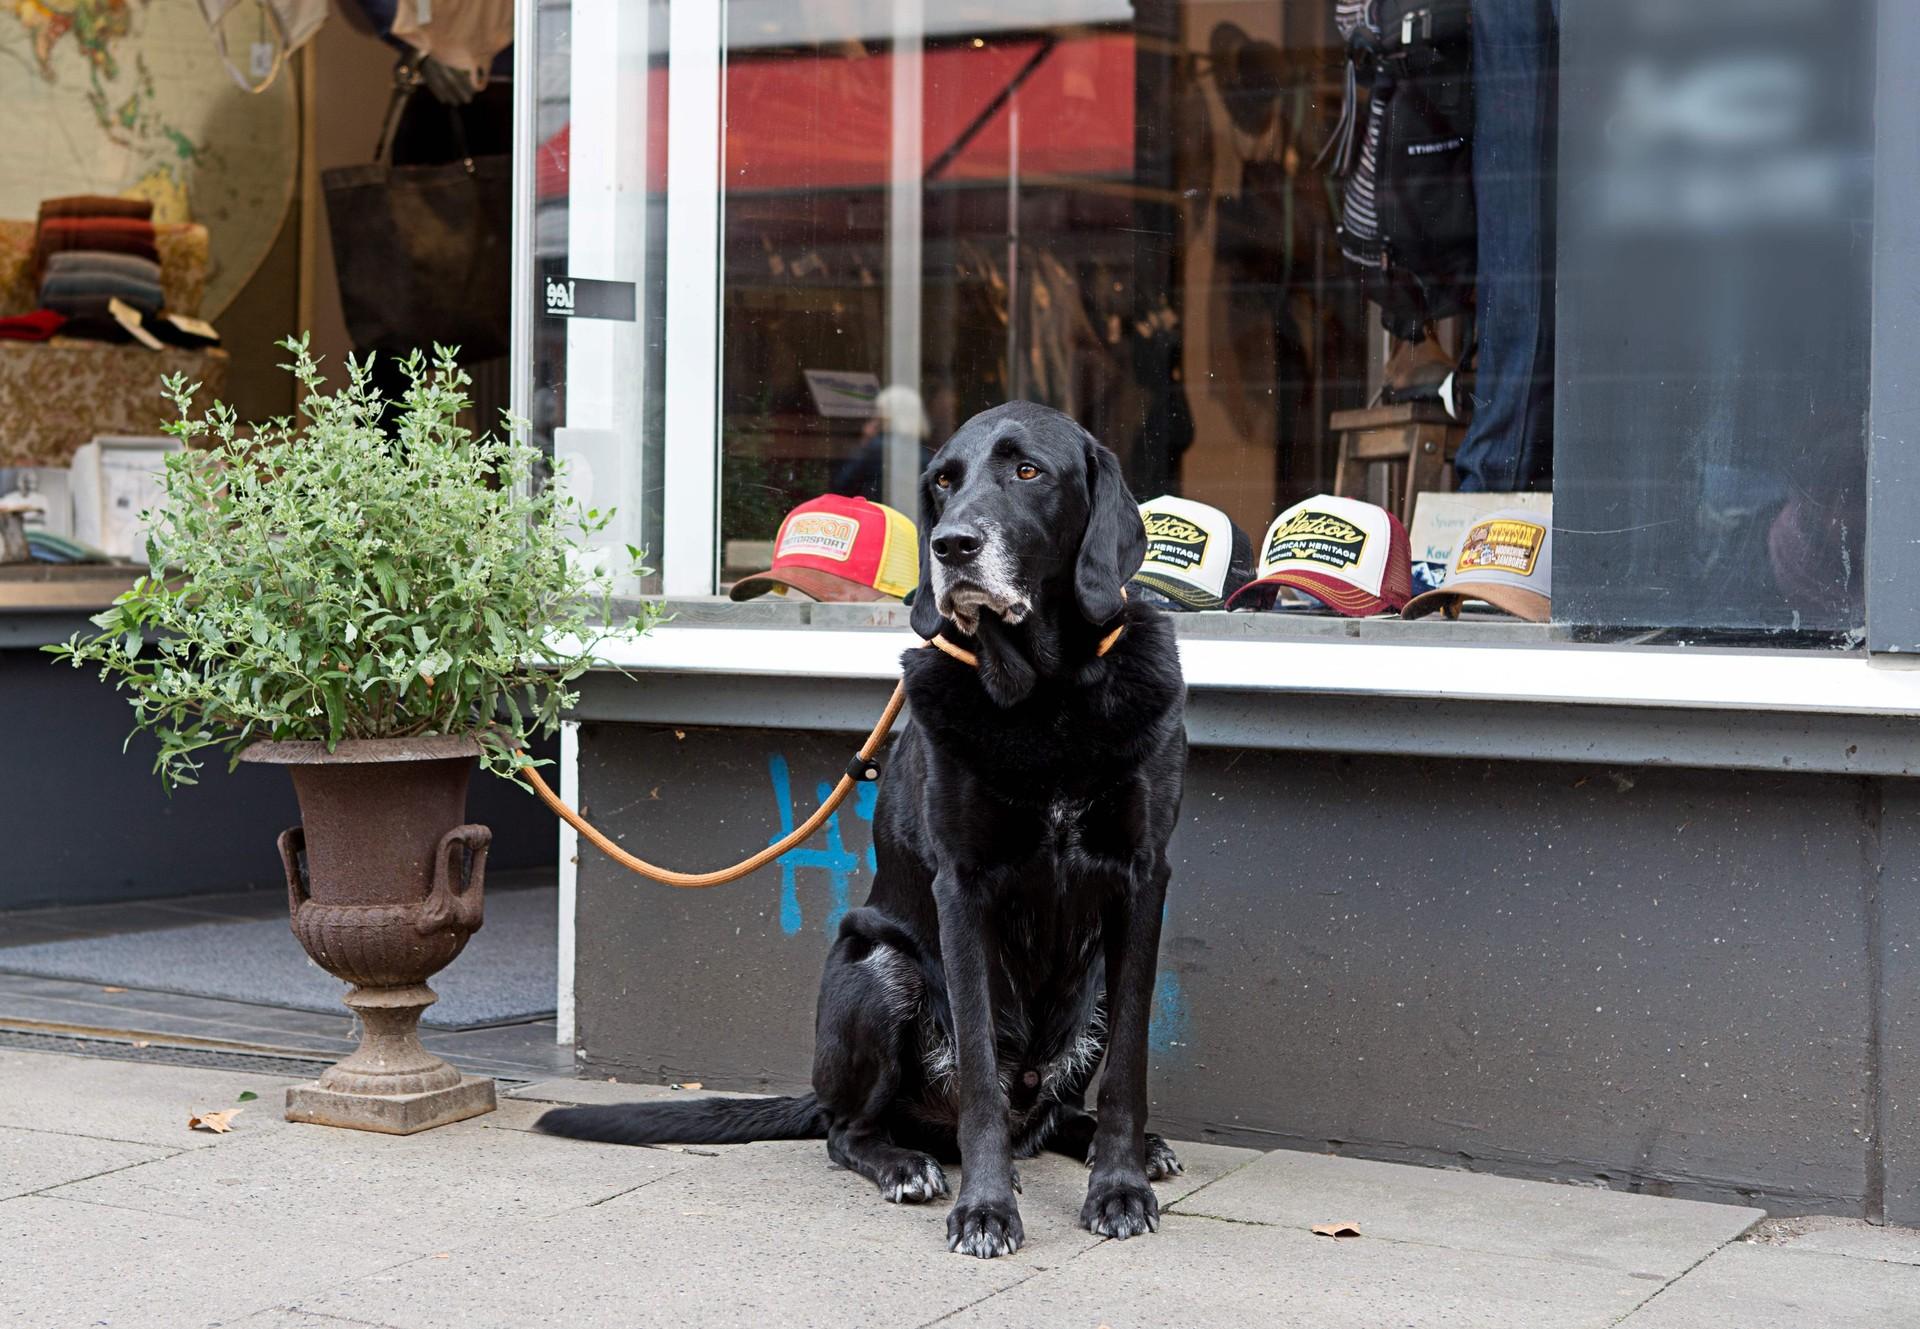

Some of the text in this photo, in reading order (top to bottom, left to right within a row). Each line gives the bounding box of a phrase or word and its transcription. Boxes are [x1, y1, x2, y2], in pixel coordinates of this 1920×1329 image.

[1273, 509, 1364, 543] Stetson
[1487, 523, 1536, 547] STETSON
[784, 535, 847, 550] TORSPORT
[1153, 543, 1200, 561] HERITAGE
[1269, 541, 1307, 556] AMERICAN
[1309, 541, 1357, 561] HERITAGE
